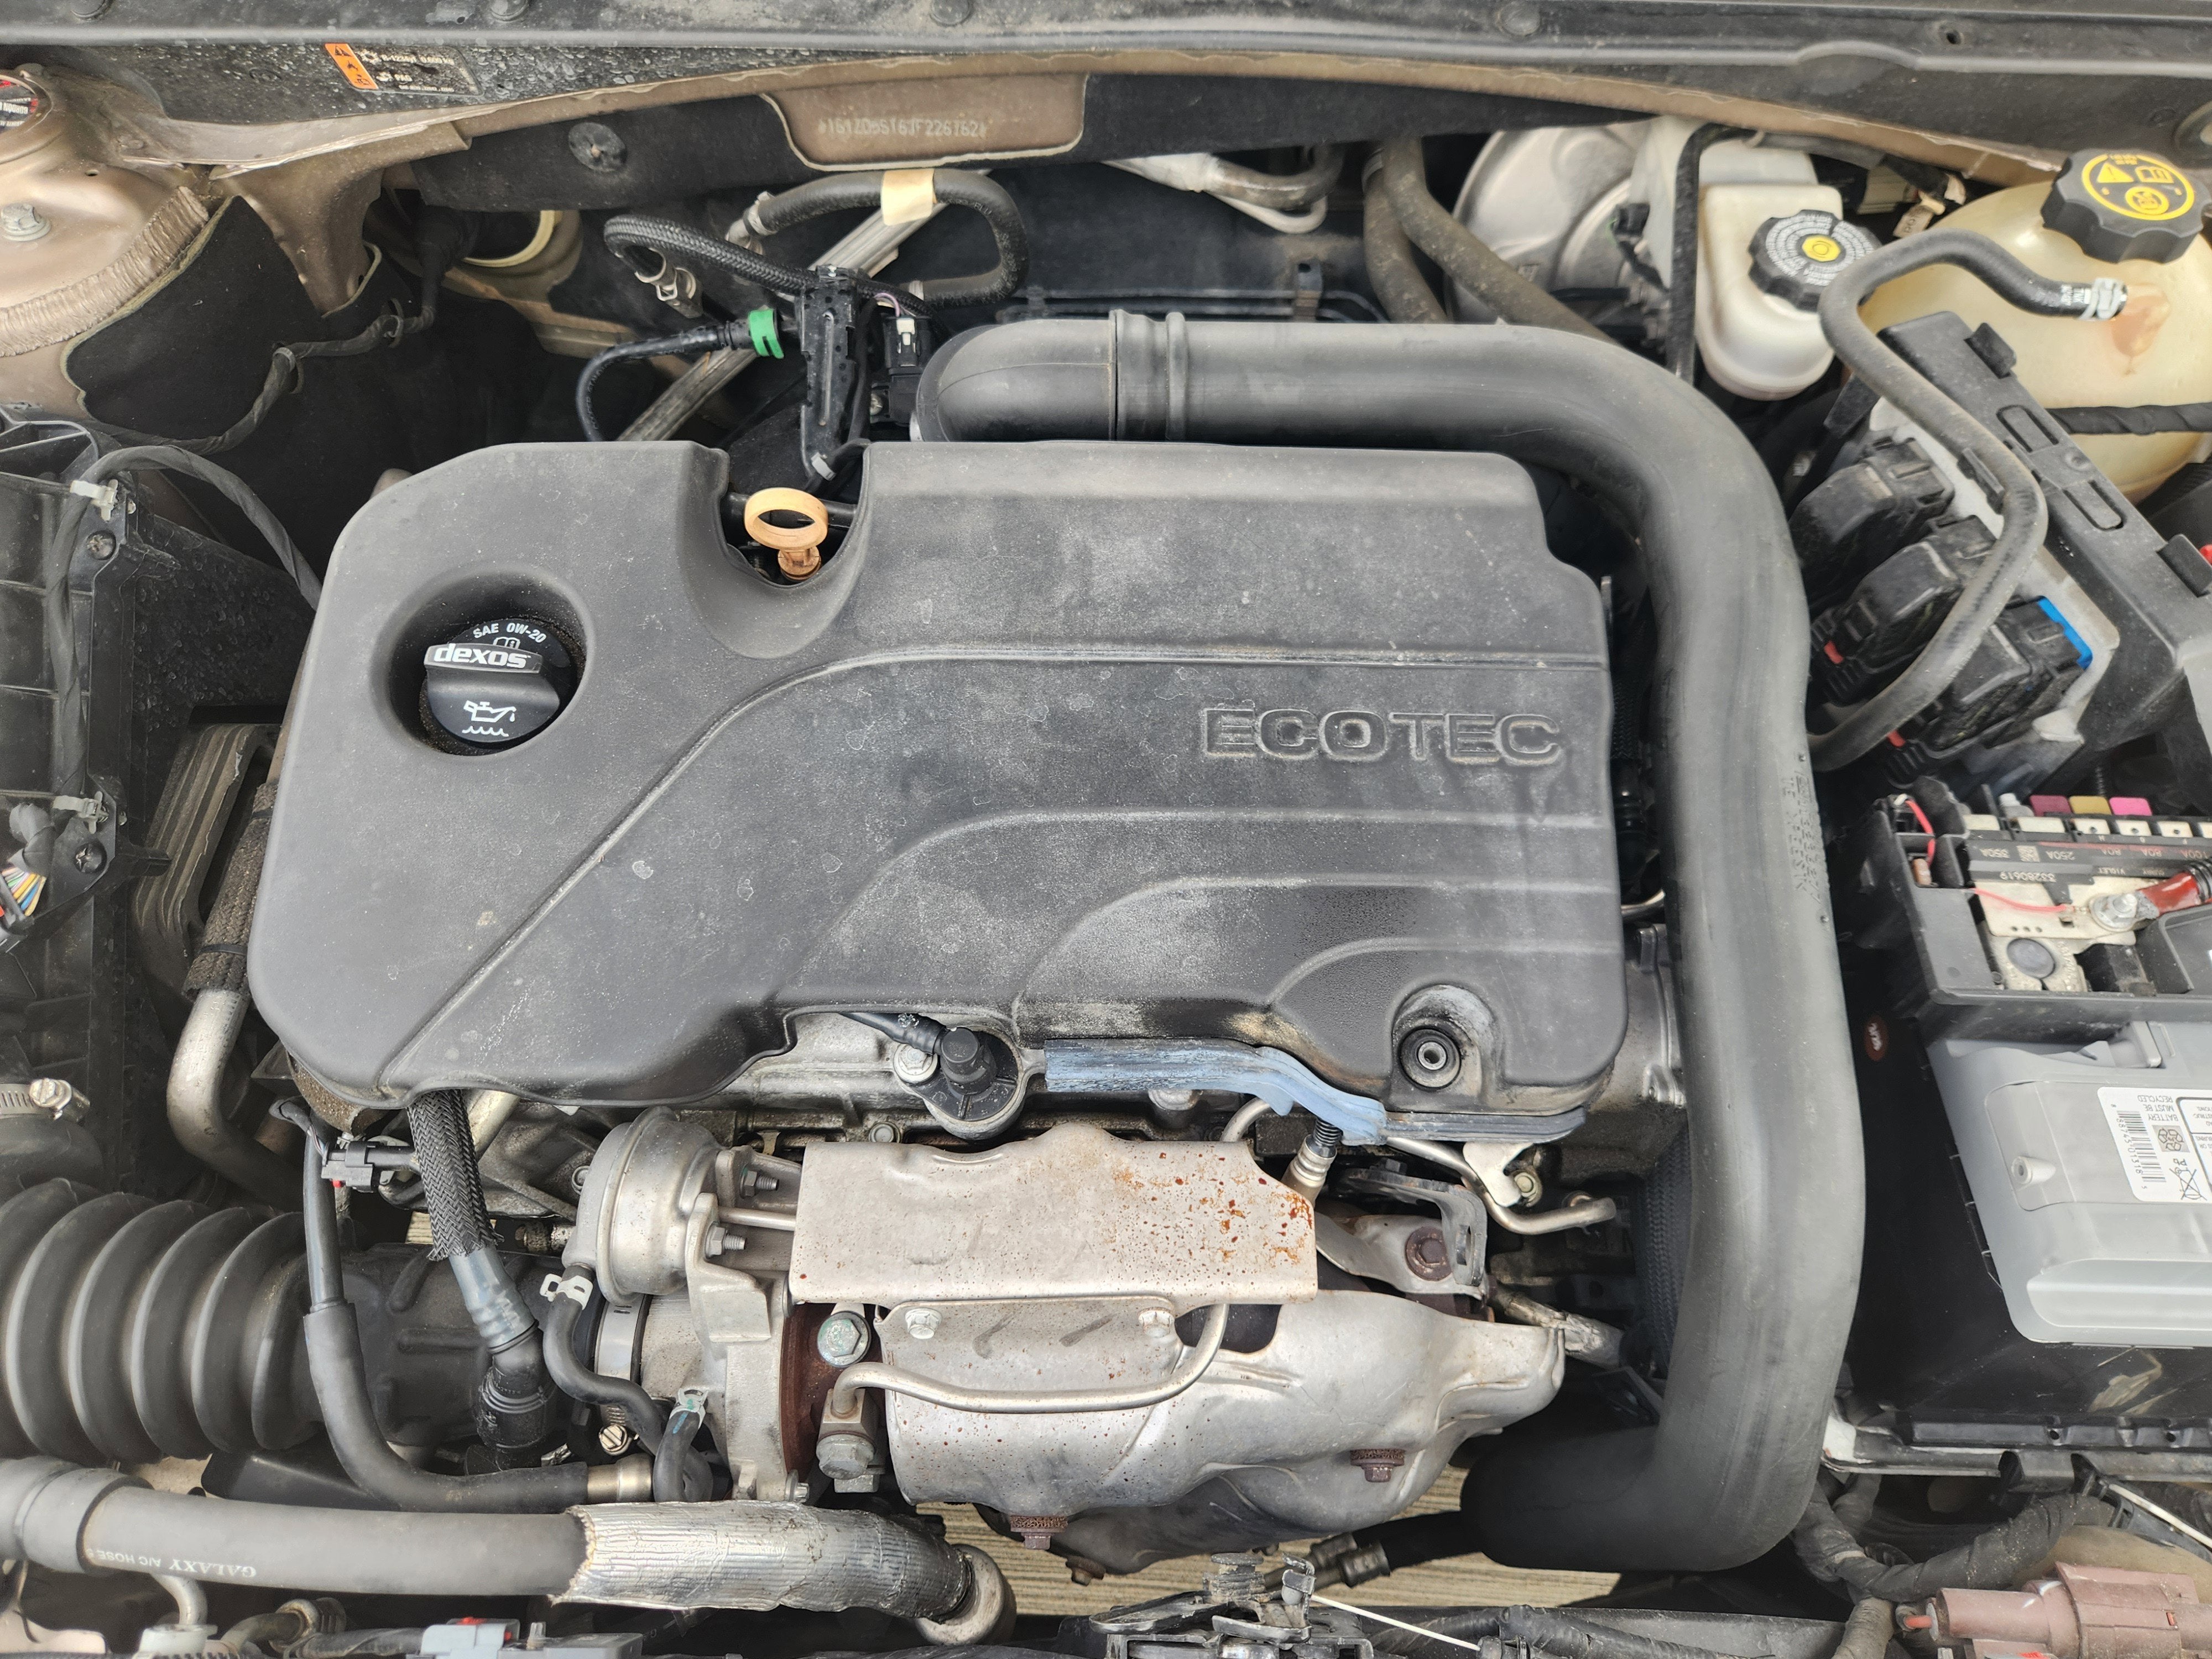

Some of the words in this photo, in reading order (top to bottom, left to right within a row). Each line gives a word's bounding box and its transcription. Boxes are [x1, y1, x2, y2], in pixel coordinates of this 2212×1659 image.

[473, 623, 499, 639] SAE
[506, 623, 547, 643] 0W-20
[434, 643, 528, 669] dexos
[1202, 707, 1561, 766] ECOTEC
[2046, 851, 2076, 861] 250A
[2000, 871, 2057, 883] 33280619
[2098, 867, 2126, 875] VIOLET
[2137, 1094, 2173, 1103] RECYCLED
[2147, 1113, 2179, 1121] BATTERY
[96, 1550, 135, 1564] HOSE
[138, 1556, 161, 1567] A/C
[169, 1558, 257, 1578] GALAXY
